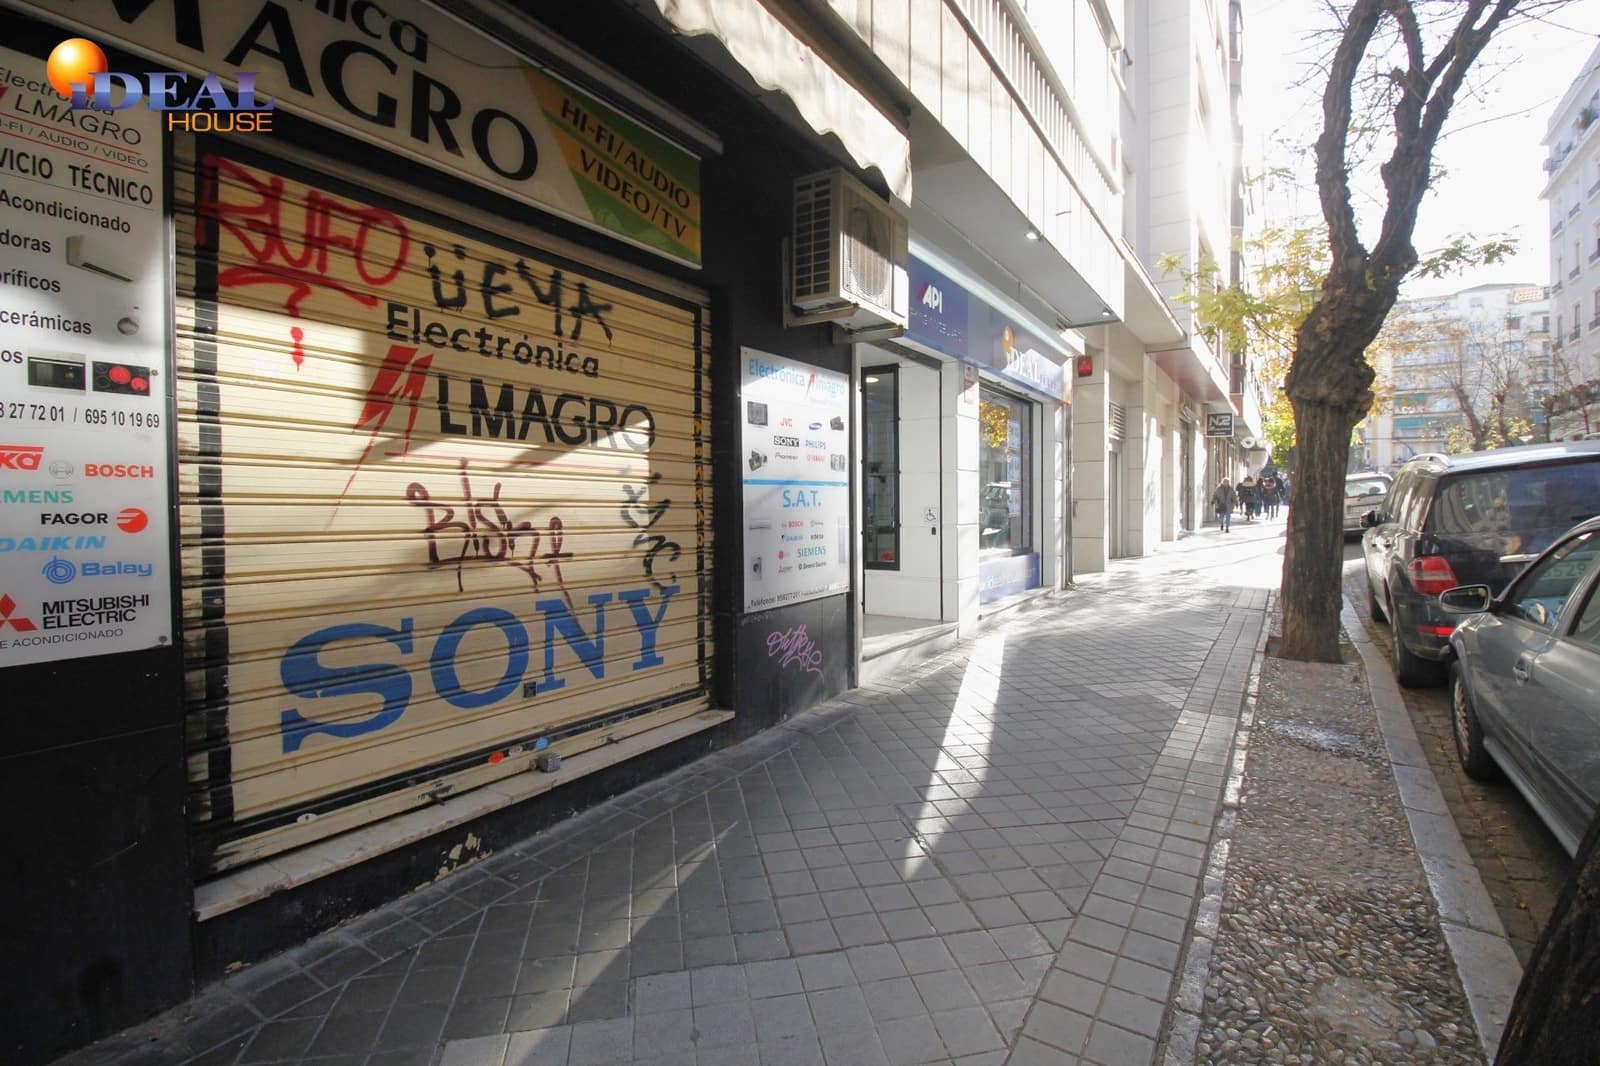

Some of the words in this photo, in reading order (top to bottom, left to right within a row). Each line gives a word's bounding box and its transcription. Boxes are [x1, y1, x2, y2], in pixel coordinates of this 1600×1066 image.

[15, 93, 142, 146] LMAGRO
[38, 130, 89, 151] AUDIO
[101, 146, 148, 169] VIDEO
[560, 97, 690, 209] HI-FI/AUDIO
[68, 163, 153, 205] TÉCNICO
[578, 148, 688, 239] VIDEO/TV
[0, 188, 131, 234] Acondicionado
[0, 268, 61, 293] ríficos
[386, 302, 599, 379] Electrónica
[85, 408, 107, 426] 695
[773, 435, 800, 448] SONY
[84, 463, 154, 478] BOSCH
[782, 488, 823, 509] S.A.T.
[40, 512, 109, 526] FAGOR
[0, 536, 107, 552] DAIKIN
[81, 560, 153, 577] Balay
[42, 593, 150, 616] MITSUBISHI
[43, 608, 137, 630] ELECTRIC
[12, 627, 124, 649] ACONDICIONADO
[280, 585, 680, 754] SONY
